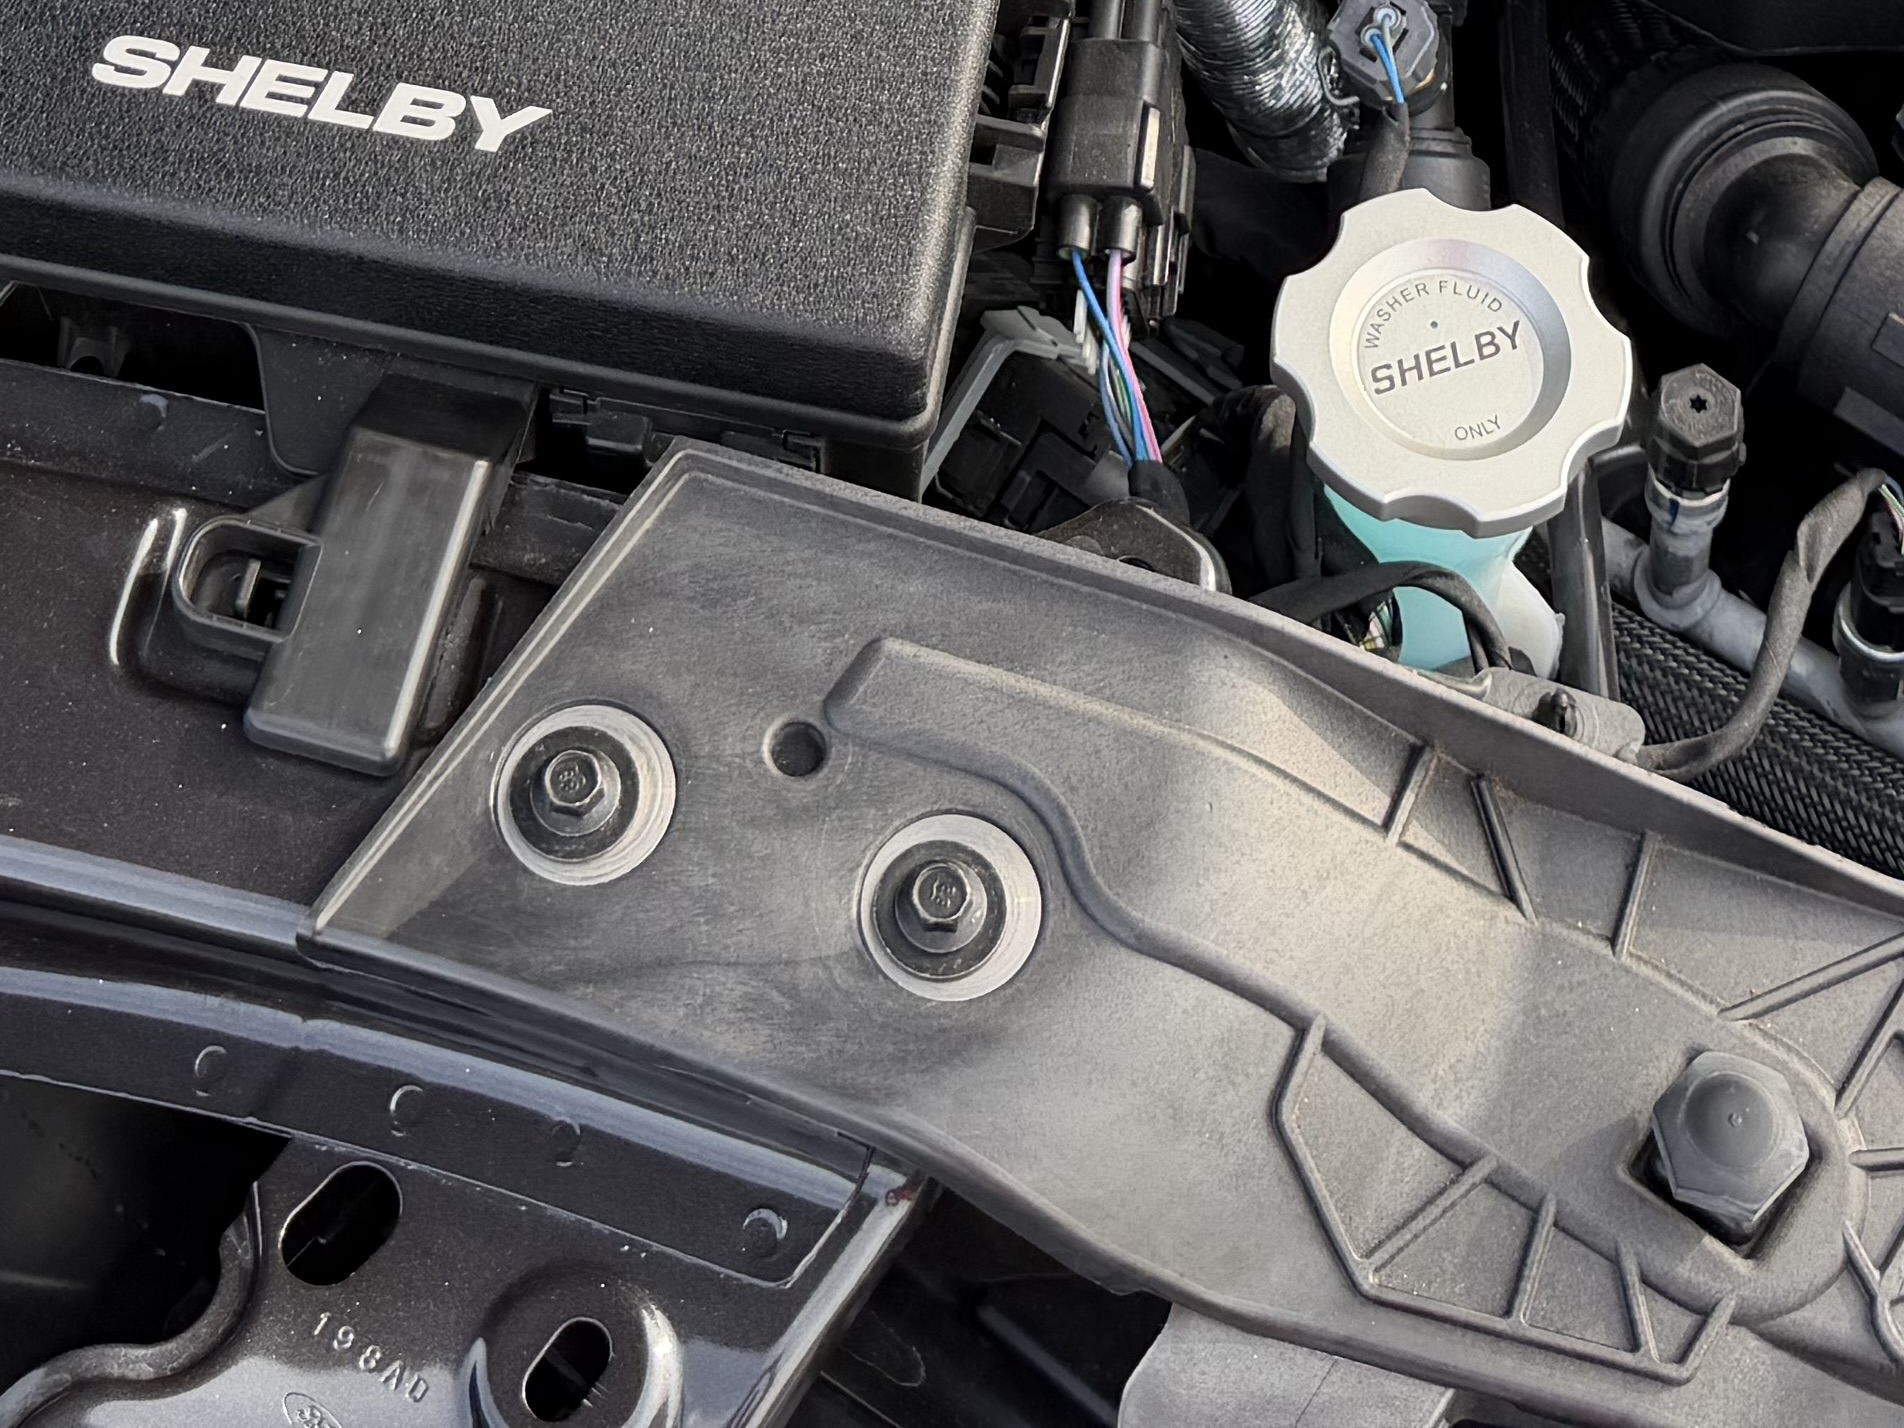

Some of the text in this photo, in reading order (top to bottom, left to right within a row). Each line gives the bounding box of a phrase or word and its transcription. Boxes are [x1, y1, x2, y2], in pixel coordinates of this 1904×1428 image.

[90, 34, 554, 154] SHELBY
[1363, 279, 1503, 350] WASHER FLUID
[1370, 319, 1521, 396] SHELBY
[1453, 414, 1502, 442] ONLY
